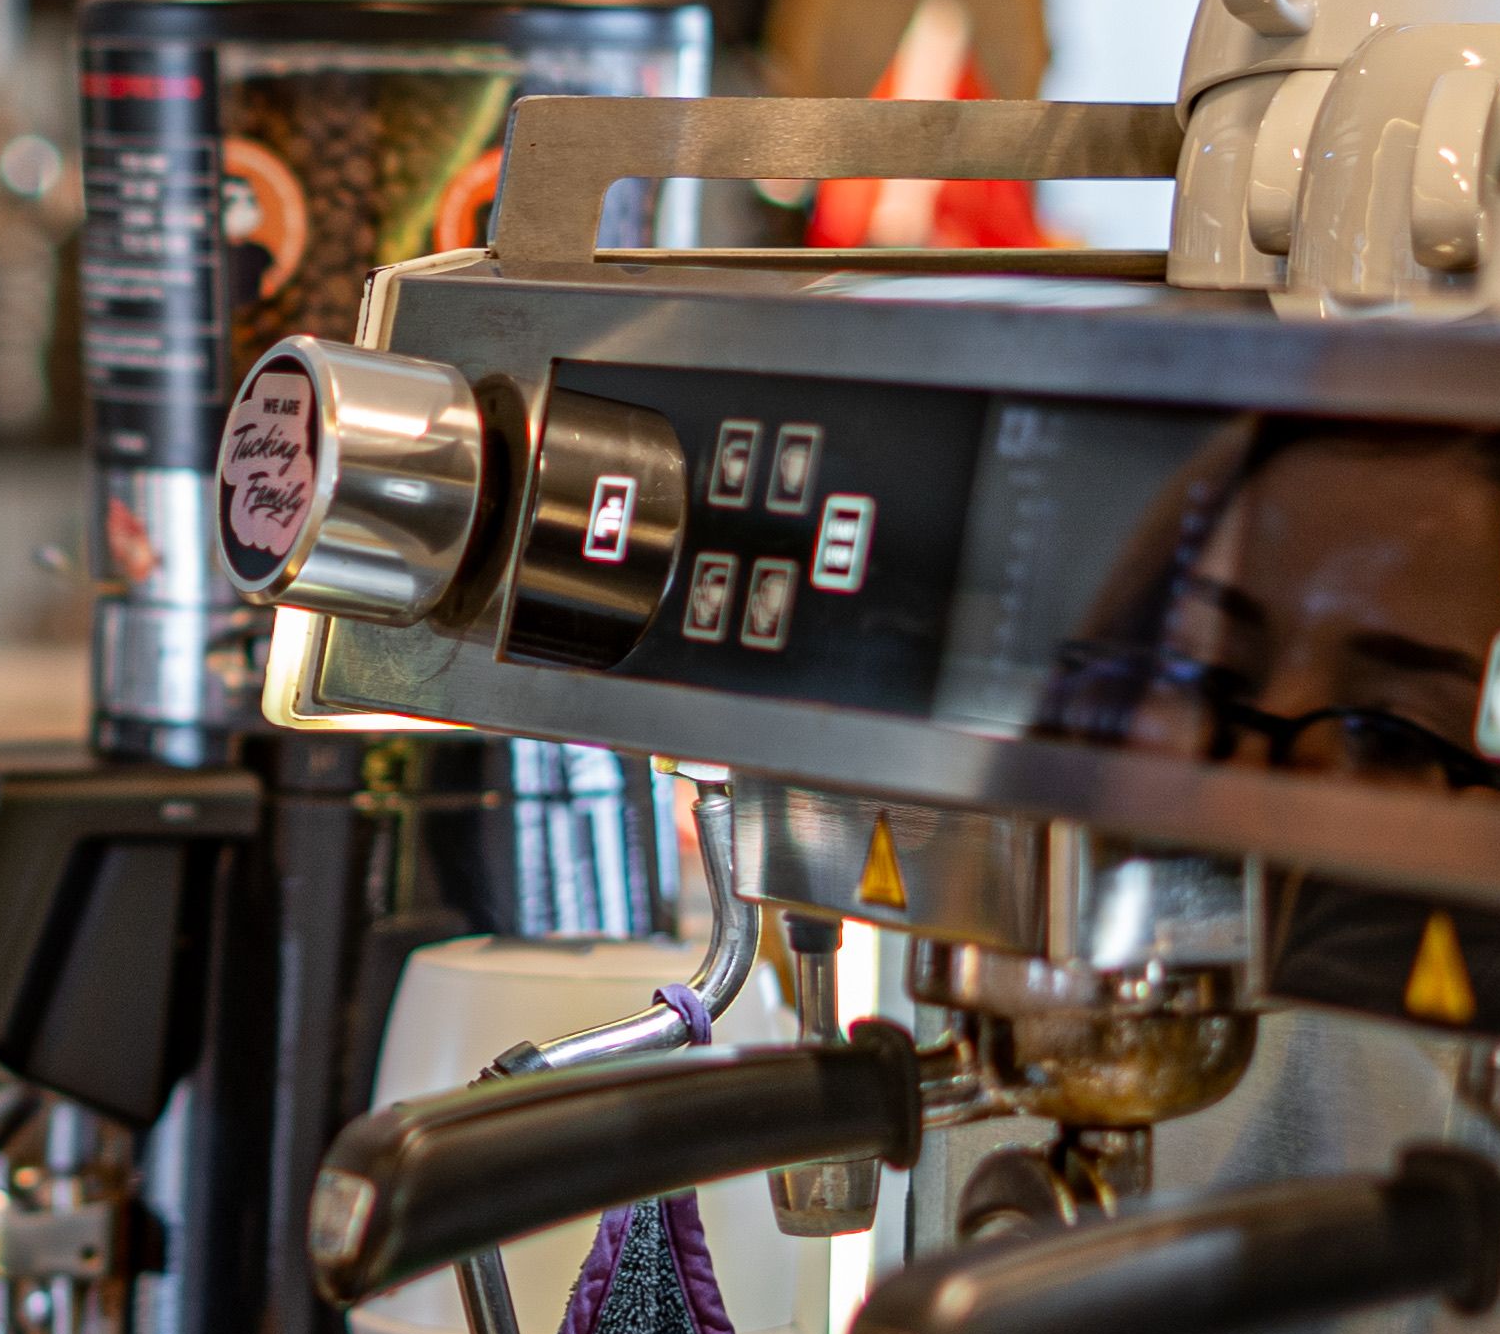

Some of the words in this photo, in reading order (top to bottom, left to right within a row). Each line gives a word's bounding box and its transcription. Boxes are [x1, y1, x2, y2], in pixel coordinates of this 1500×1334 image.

[263, 398, 278, 415] WE
[281, 399, 301, 417] ARE
[243, 471, 306, 529] Family
